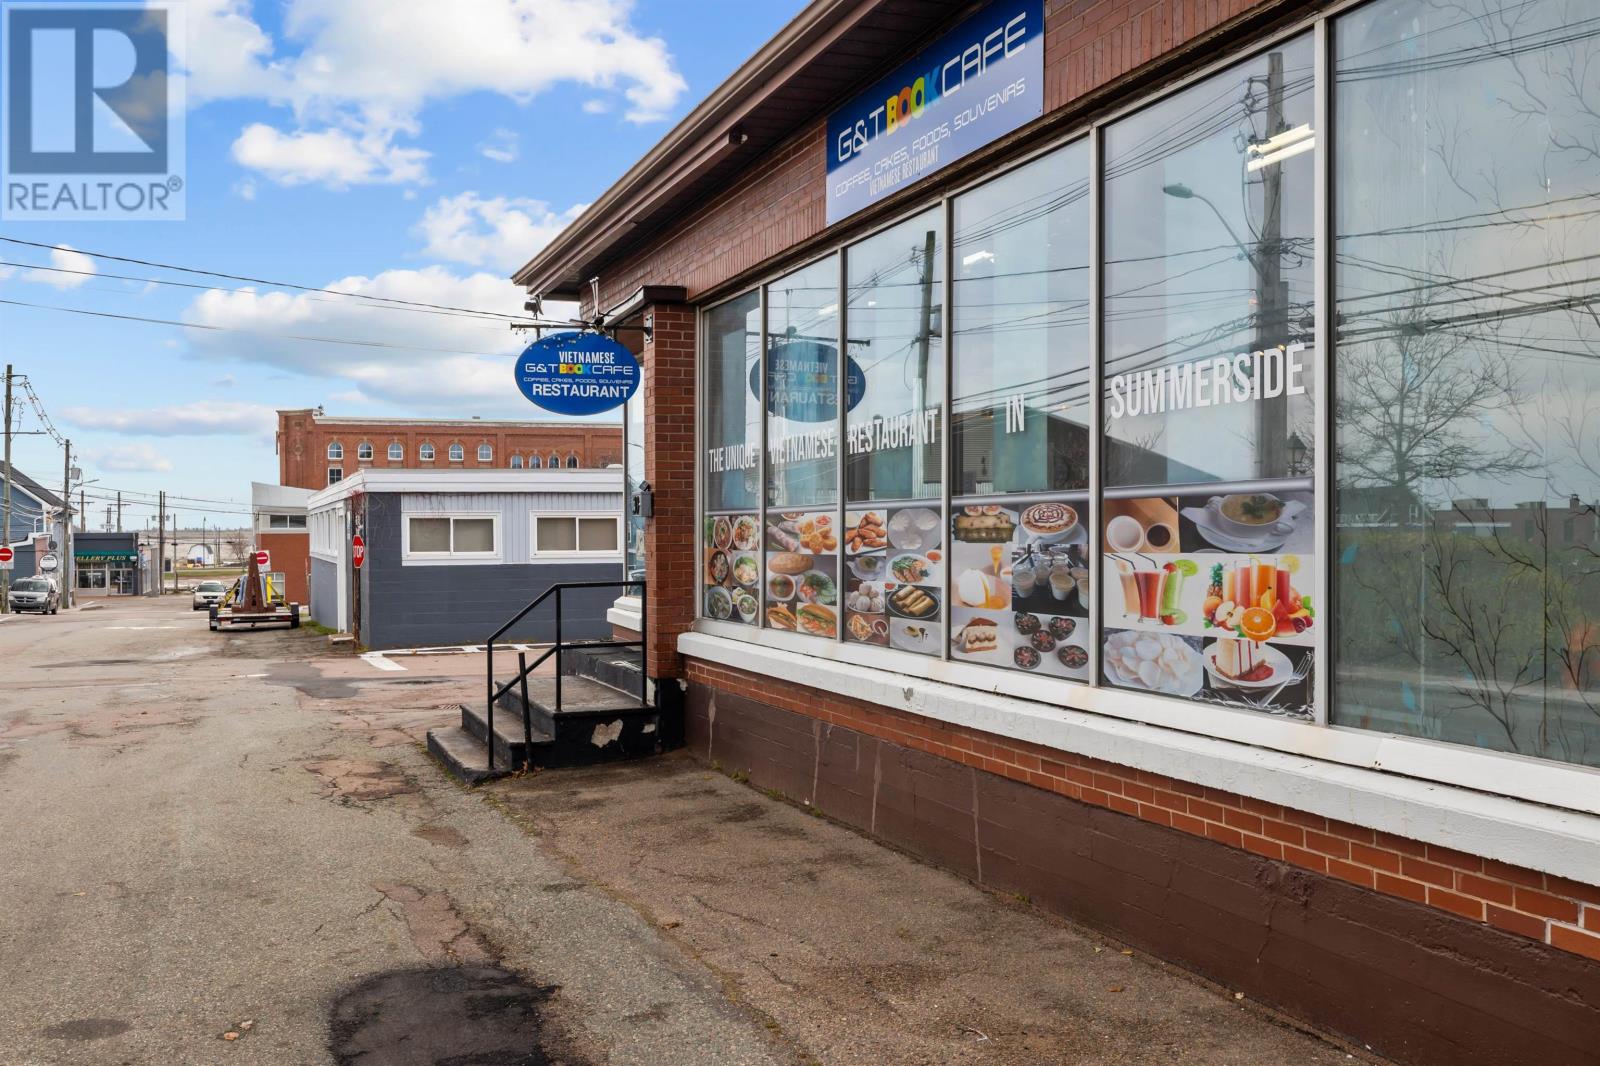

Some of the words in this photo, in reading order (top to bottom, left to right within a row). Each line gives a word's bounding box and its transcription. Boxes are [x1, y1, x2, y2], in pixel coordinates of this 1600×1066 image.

[838, 105, 885, 162] G&T
[886, 65, 941, 136] BOOK
[942, 11, 1026, 97] CAFE
[913, 122, 951, 155] FOODS,
[953, 77, 1025, 131] SOUVENIRS
[902, 144, 939, 180] RESTAURANT
[525, 363, 558, 373] G&T
[559, 363, 592, 375] BOOK
[592, 365, 633, 375] CAFE
[559, 351, 615, 364] VIETNAMESE
[532, 384, 629, 398] RESTAURANT
[709, 447, 723, 472] THE
[725, 442, 756, 471] UNIQUE
[769, 428, 835, 464] VIETNAMESE
[849, 409, 938, 454] RESTAURANT
[1005, 393, 1025, 434] IN
[1110, 343, 1305, 419] SUMMERSIDE
